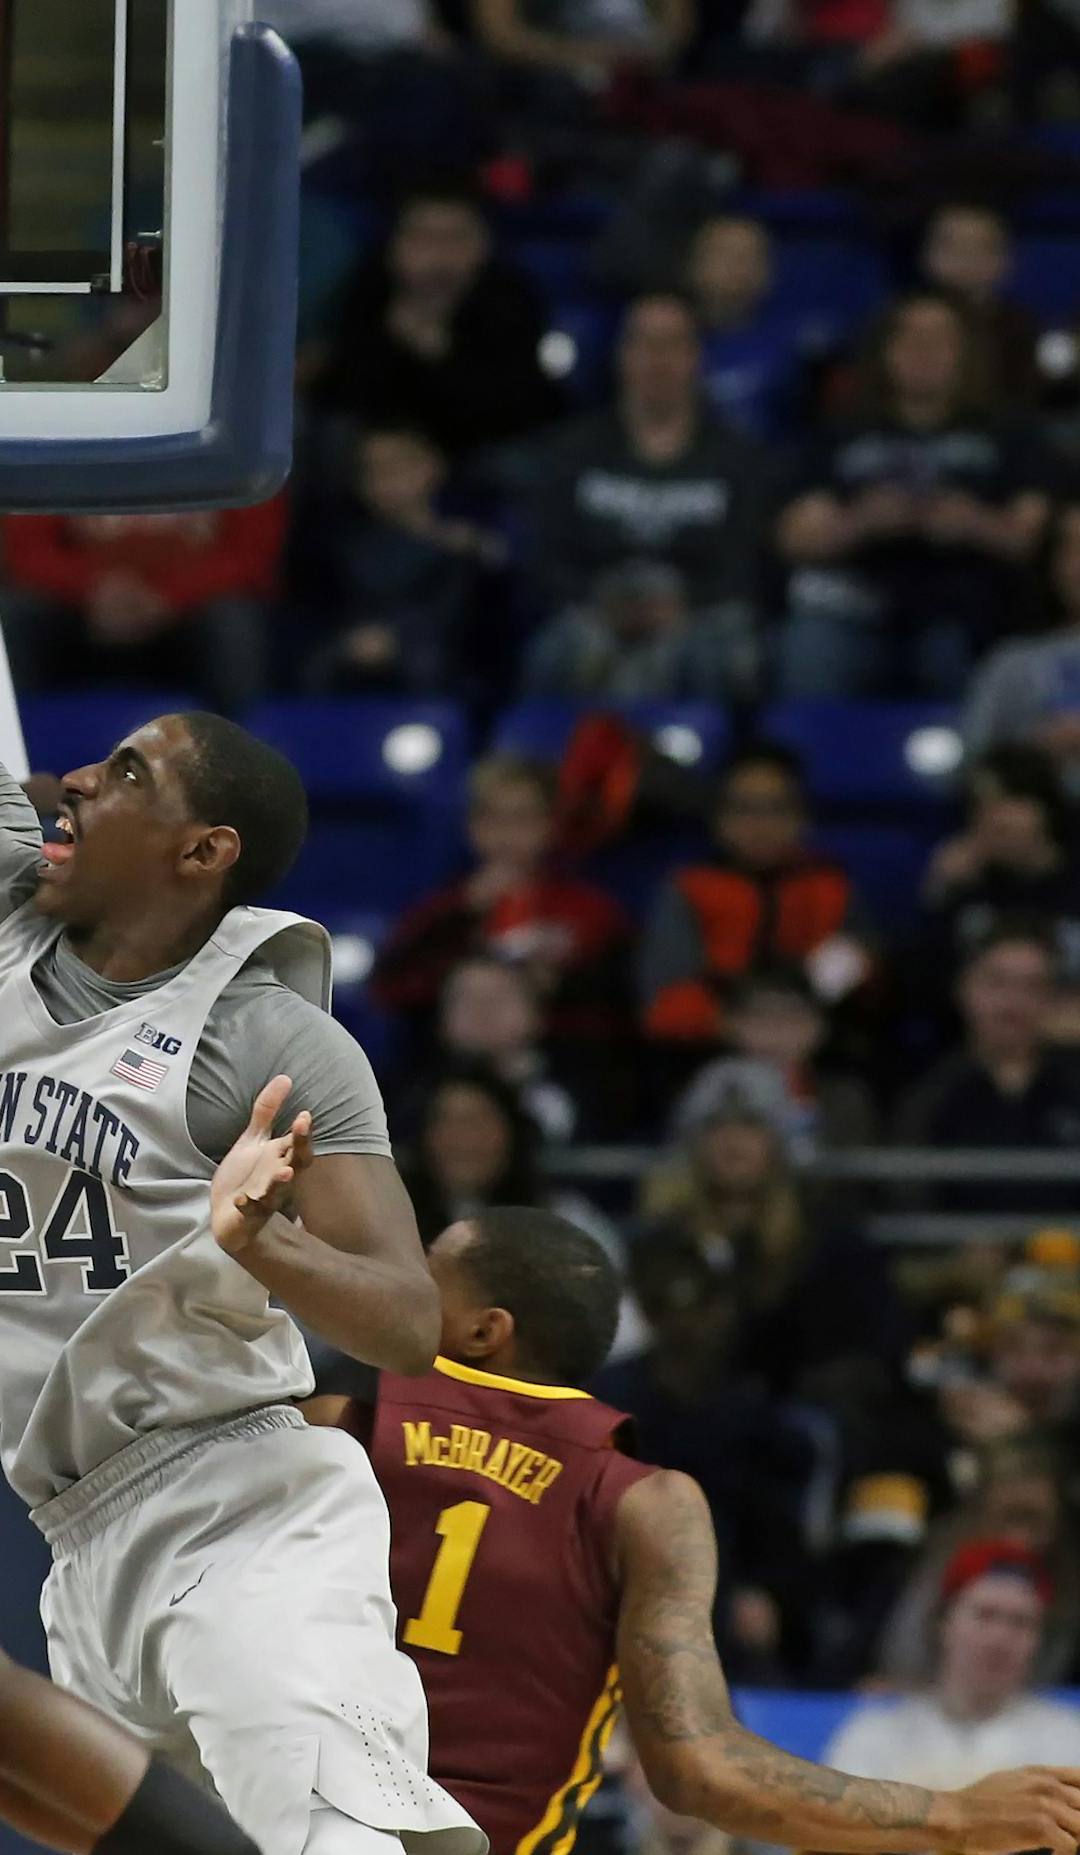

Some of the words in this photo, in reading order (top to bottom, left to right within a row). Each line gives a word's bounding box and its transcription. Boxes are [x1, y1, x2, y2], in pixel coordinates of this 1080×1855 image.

[24, 1075, 140, 1190] STATE
[402, 1421, 563, 1504] McBRAYER
[403, 1500, 491, 1655] 1
